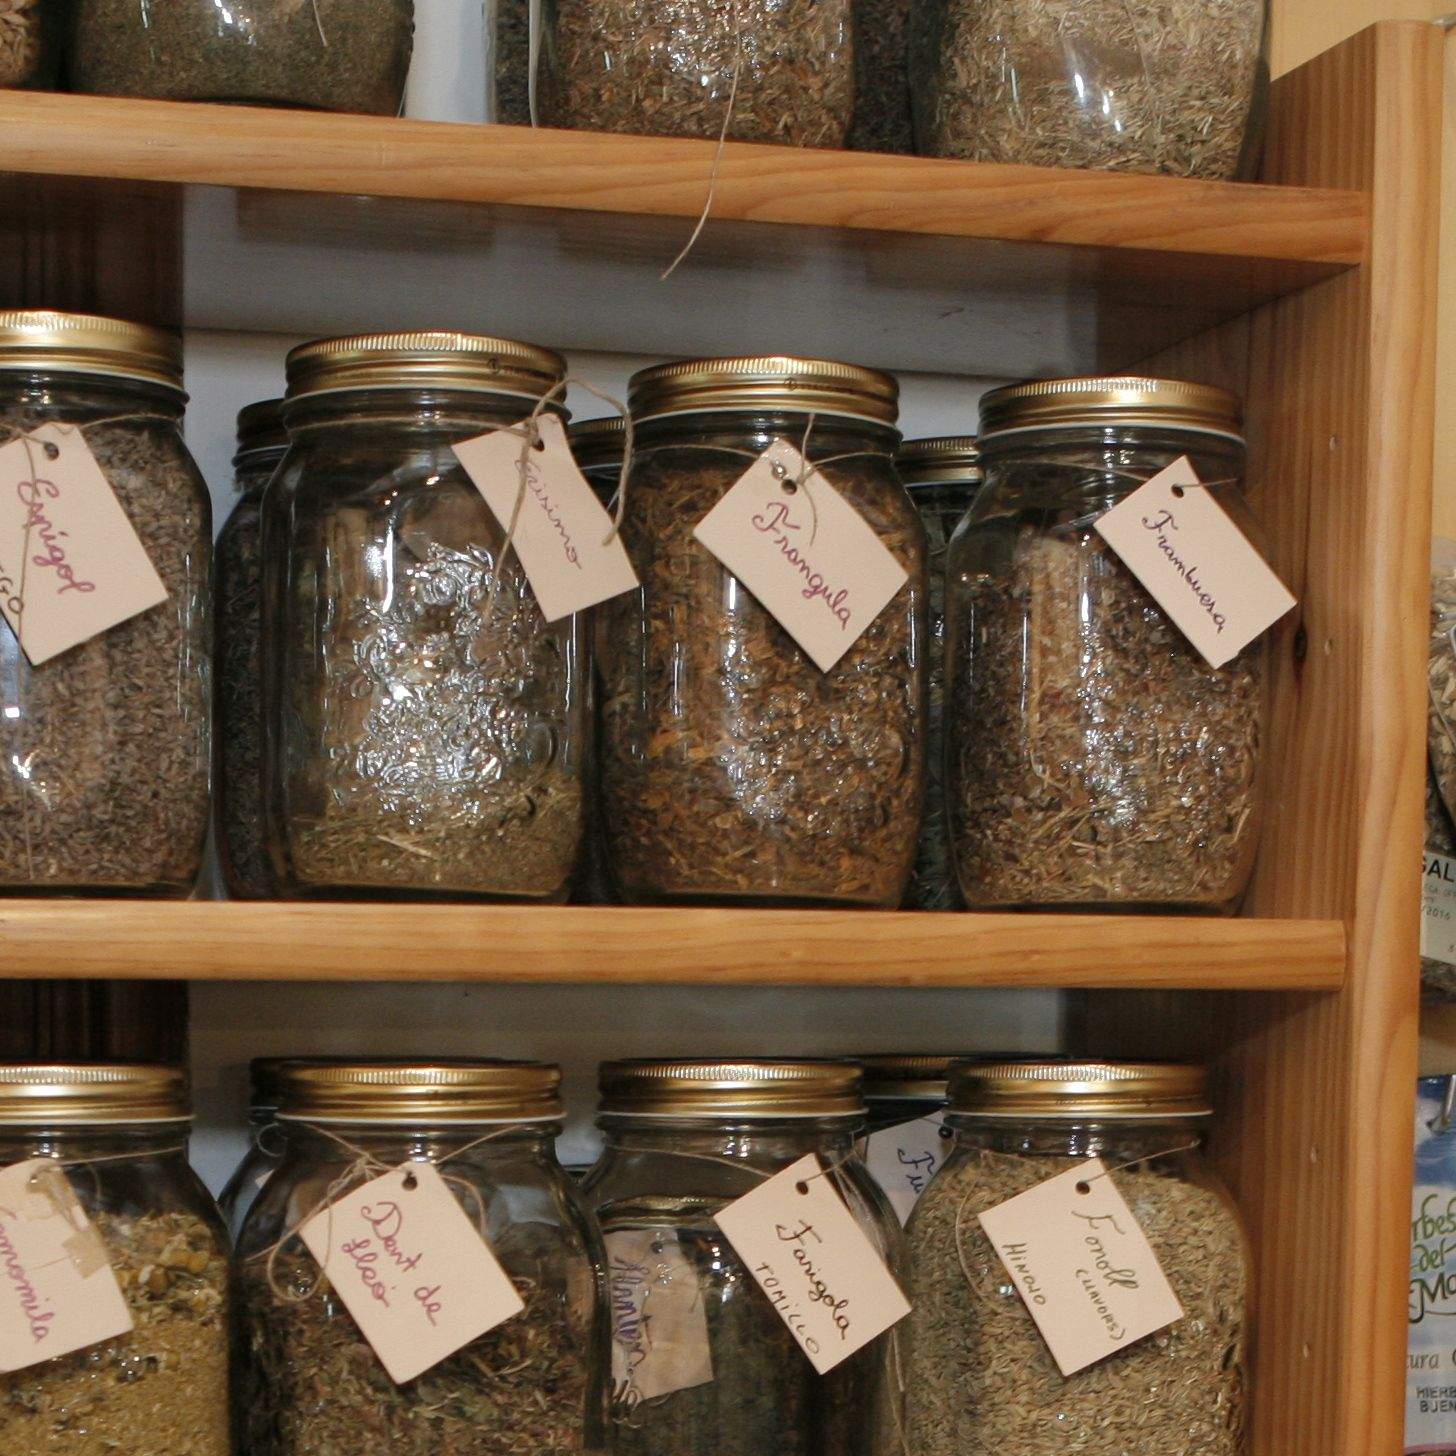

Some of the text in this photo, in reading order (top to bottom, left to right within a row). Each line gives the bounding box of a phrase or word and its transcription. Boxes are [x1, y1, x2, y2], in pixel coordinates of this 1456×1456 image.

[361, 1201, 443, 1326] Dent de
[776, 1220, 850, 1341] Farigola
